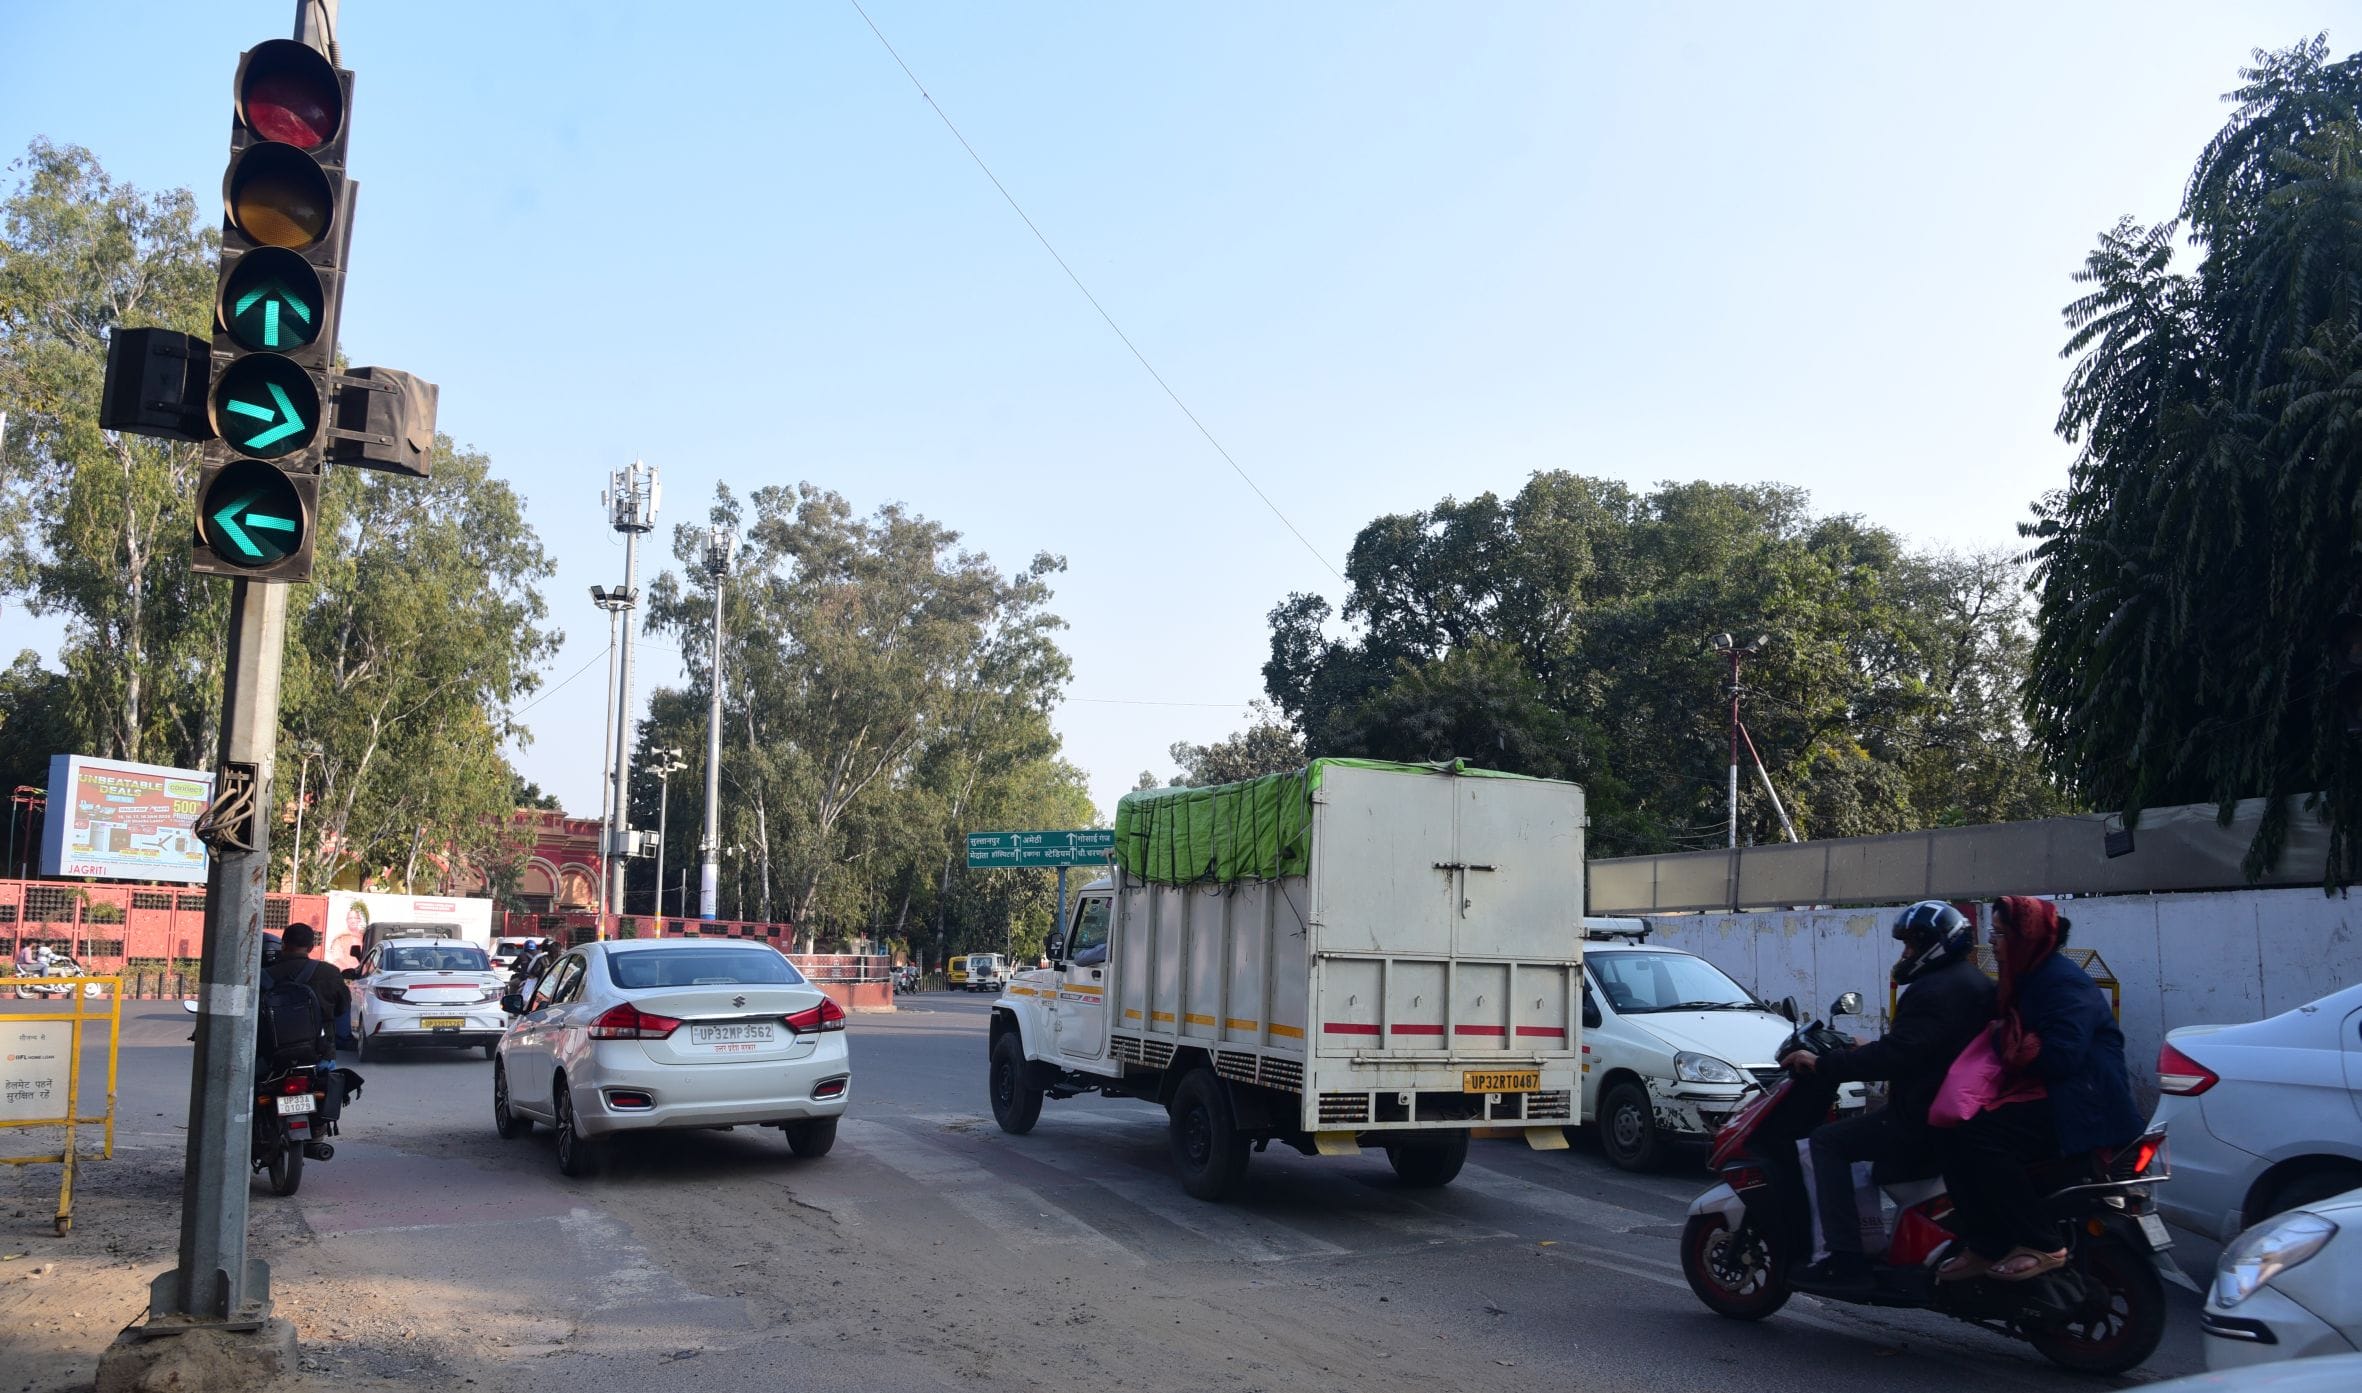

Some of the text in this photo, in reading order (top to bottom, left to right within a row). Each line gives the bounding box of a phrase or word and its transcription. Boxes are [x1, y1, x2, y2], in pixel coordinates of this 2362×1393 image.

[78, 774, 164, 792] UNBEATABLE
[99, 785, 142, 797] DEALS
[1022, 834, 1042, 845] अमेठी
[1044, 848, 1071, 858] स्टेडियम
[68, 865, 107, 876] JAGRITI
[700, 1026, 772, 1041] UP32MP3562
[5, 1078, 53, 1089] हेलमेट पहनें
[1472, 1075, 1538, 1089] UP32RT0487
[6, 1090, 34, 1103] सुरक्षित
[283, 1095, 310, 1105] UP33A
